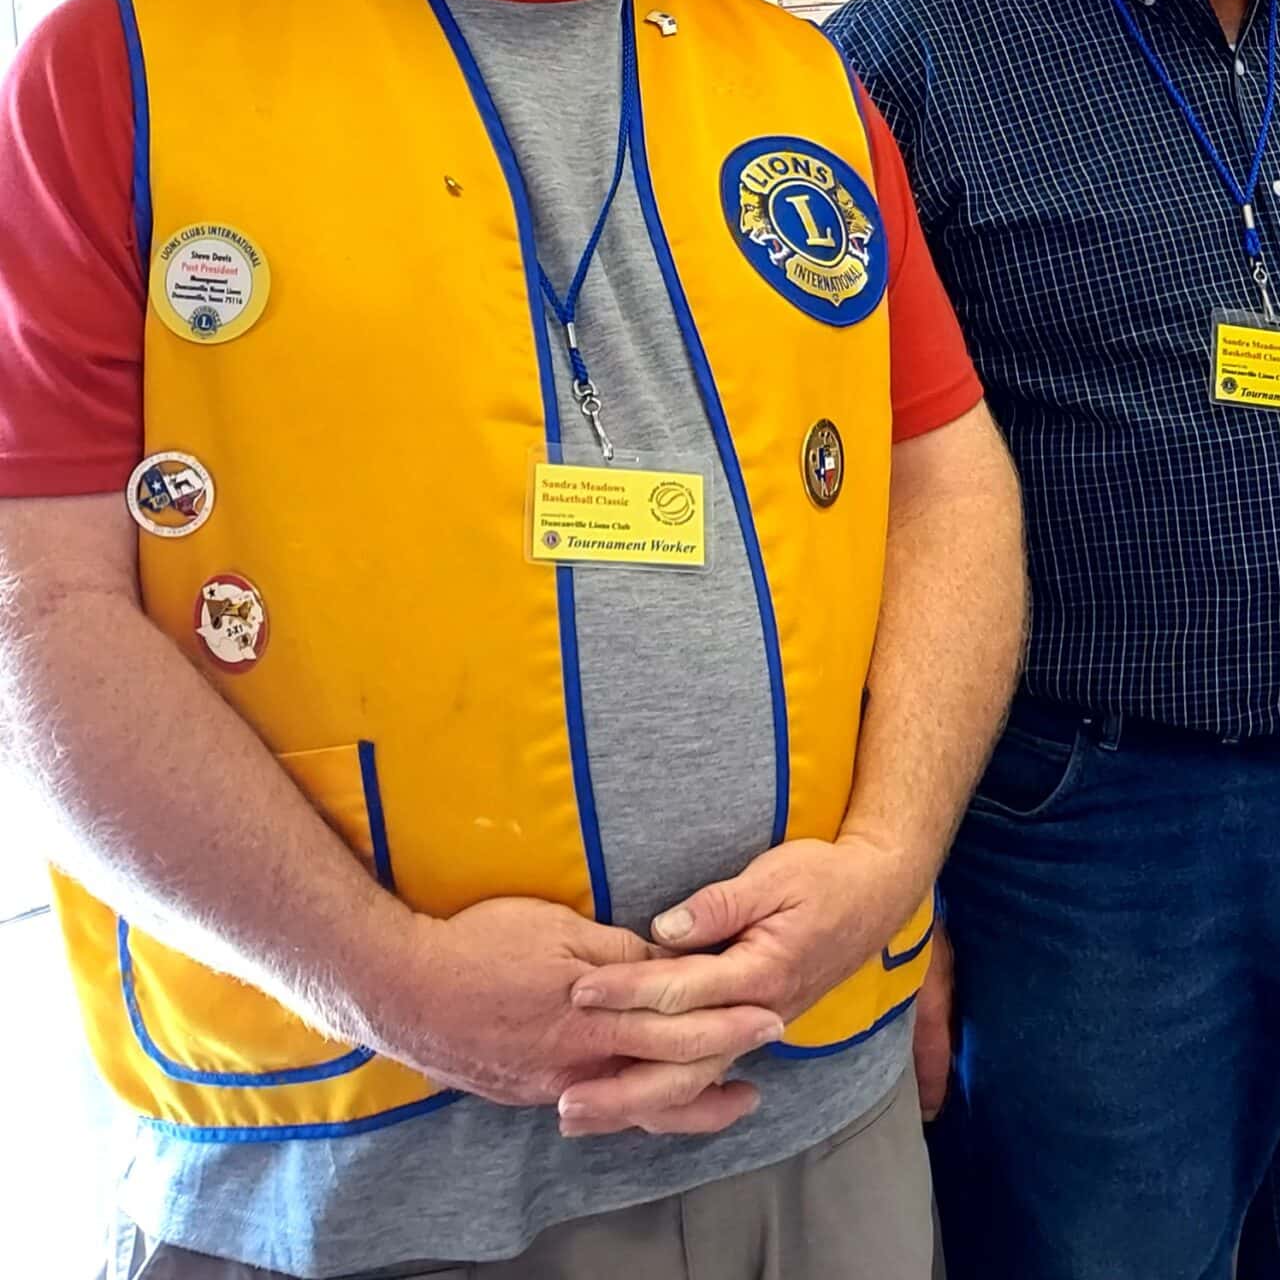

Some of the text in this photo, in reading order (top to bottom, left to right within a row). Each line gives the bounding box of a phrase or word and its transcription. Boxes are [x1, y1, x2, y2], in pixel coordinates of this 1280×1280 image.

[746, 156, 829, 188] LIONS
[785, 195, 835, 247] L
[160, 226, 261, 267] LIONS CLUBS INTERNATIONAL
[191, 251, 232, 262] Steve Davis
[182, 263, 238, 275] Past President
[793, 263, 863, 293] INTERNATIONAL
[542, 479, 625, 493] Sandra Meadows
[542, 493, 629, 507] Basketball Classic
[541, 519, 631, 531] Duncanville Lions Club
[567, 536, 697, 554] Tournament Worker
